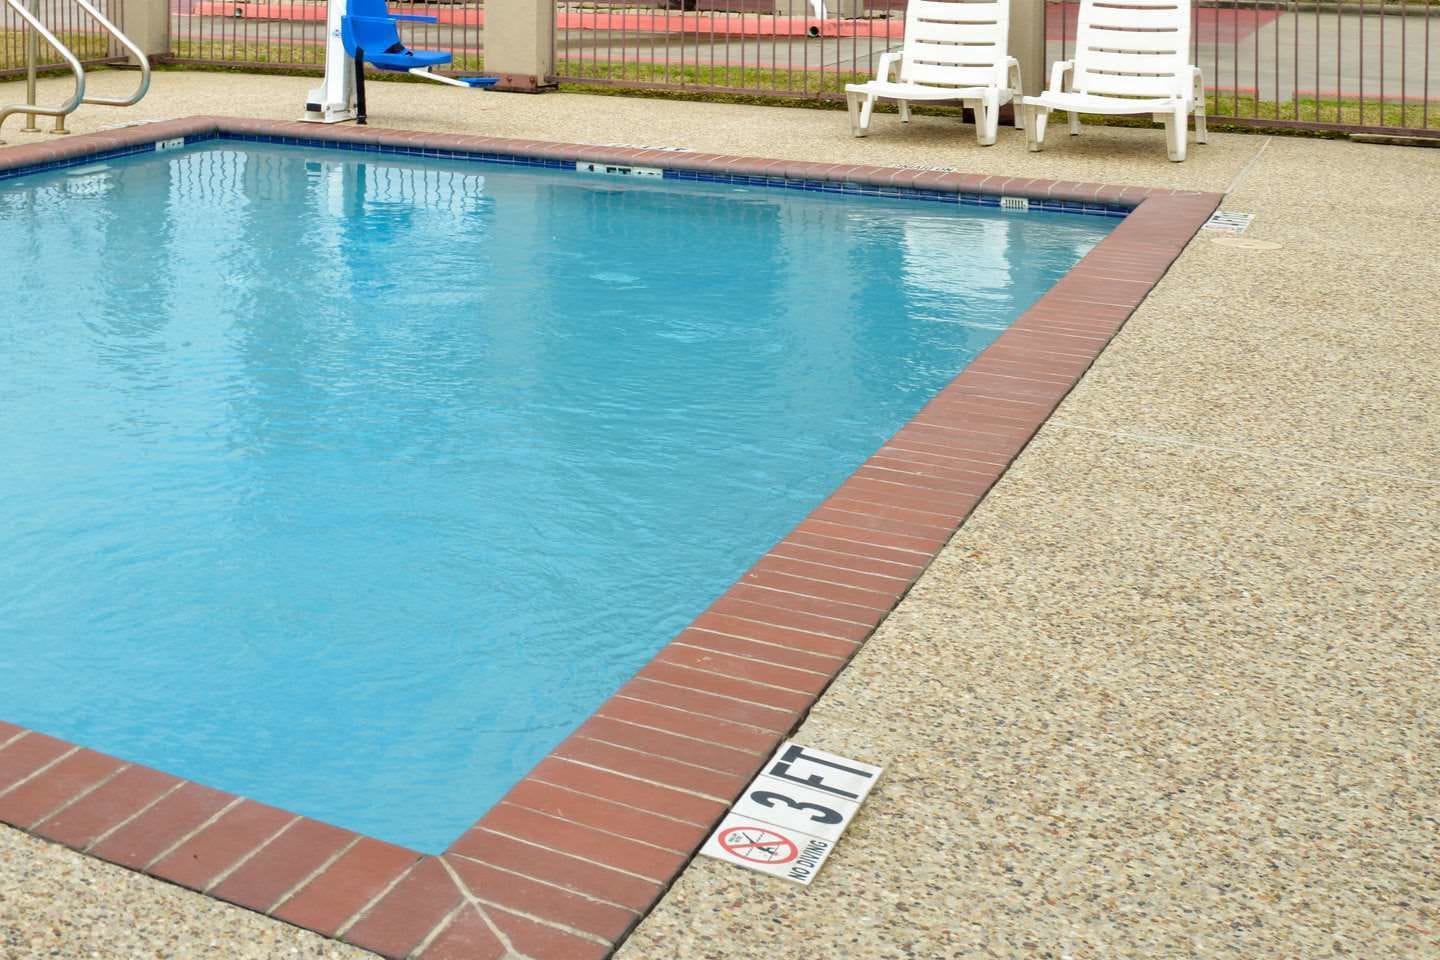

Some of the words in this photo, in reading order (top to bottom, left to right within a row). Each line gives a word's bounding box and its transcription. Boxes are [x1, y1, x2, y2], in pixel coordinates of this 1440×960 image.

[769, 744, 873, 800] FT
[750, 790, 844, 825] 3
[796, 840, 828, 868] DIVING
[788, 867, 810, 881] NO
